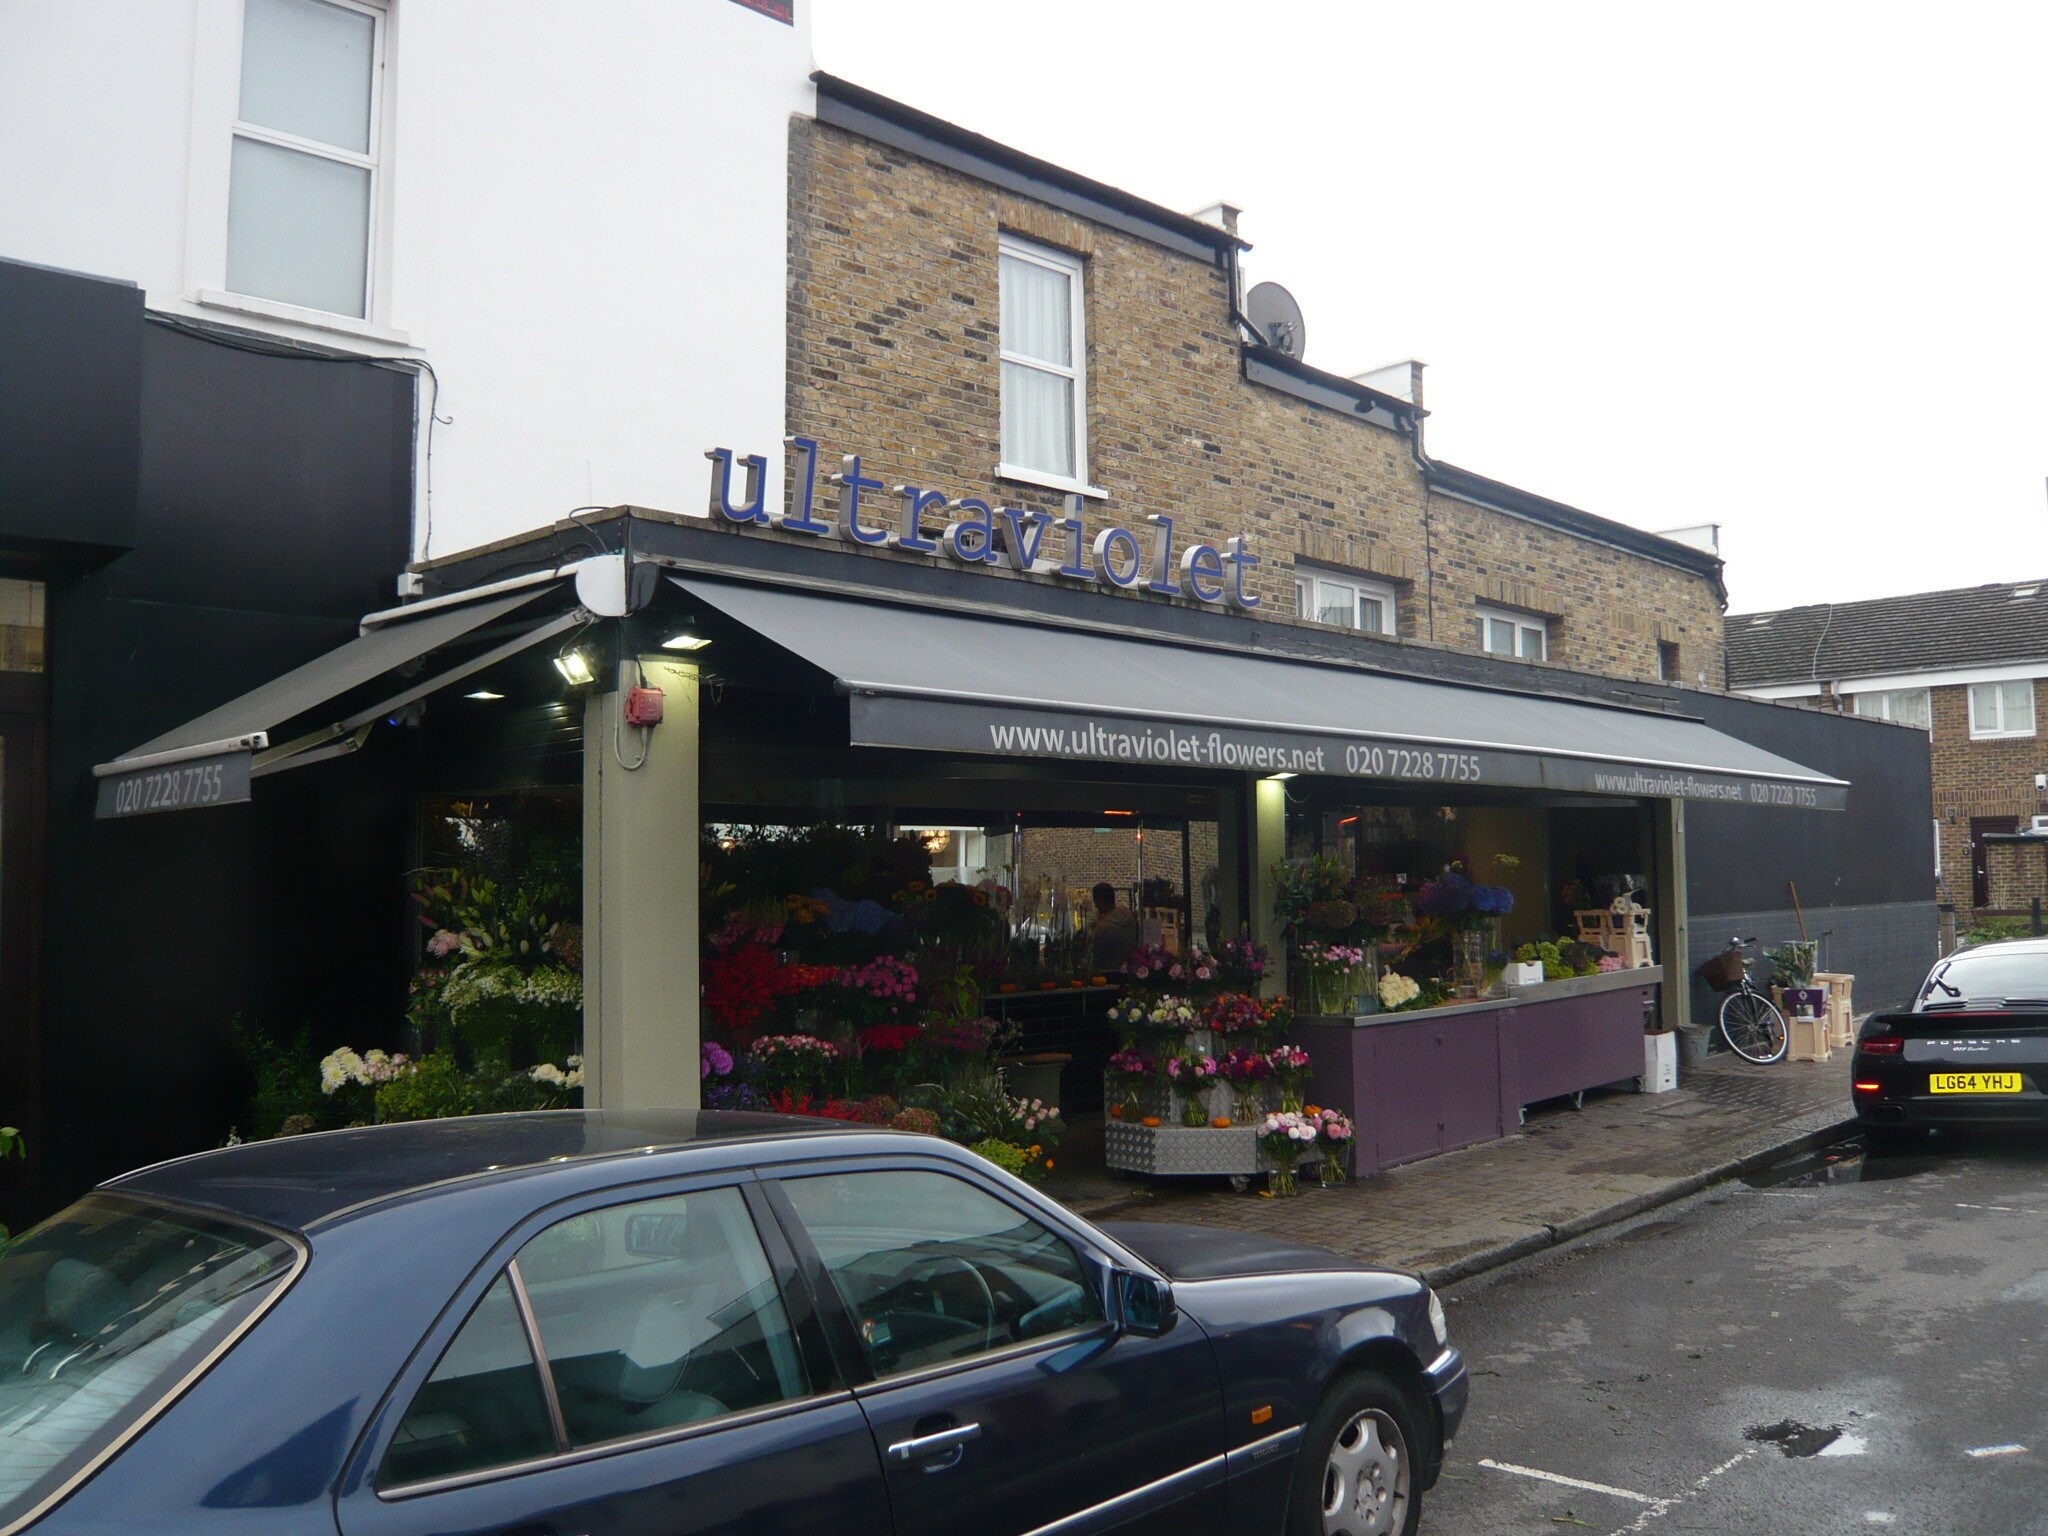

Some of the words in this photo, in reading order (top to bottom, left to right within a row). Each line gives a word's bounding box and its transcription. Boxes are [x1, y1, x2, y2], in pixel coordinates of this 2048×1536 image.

[704, 437, 1262, 609] ultraviolet
[990, 722, 1325, 772] www.ultraviolet-flowers.net
[1346, 745, 1384, 776] 020
[1387, 749, 1434, 779] 7228
[1438, 753, 1480, 782] 7755
[116, 778, 142, 813] 020
[144, 770, 180, 809] 7228
[183, 764, 223, 804] 7755
[1595, 771, 1742, 801] www.ultraviolet-flowers.net
[1750, 783, 1769, 804] 020
[1770, 785, 1793, 805] 7228
[1795, 787, 1816, 807] 7755
[1936, 1075, 1976, 1090] LG64
[1982, 1075, 2014, 1089] YHJ
